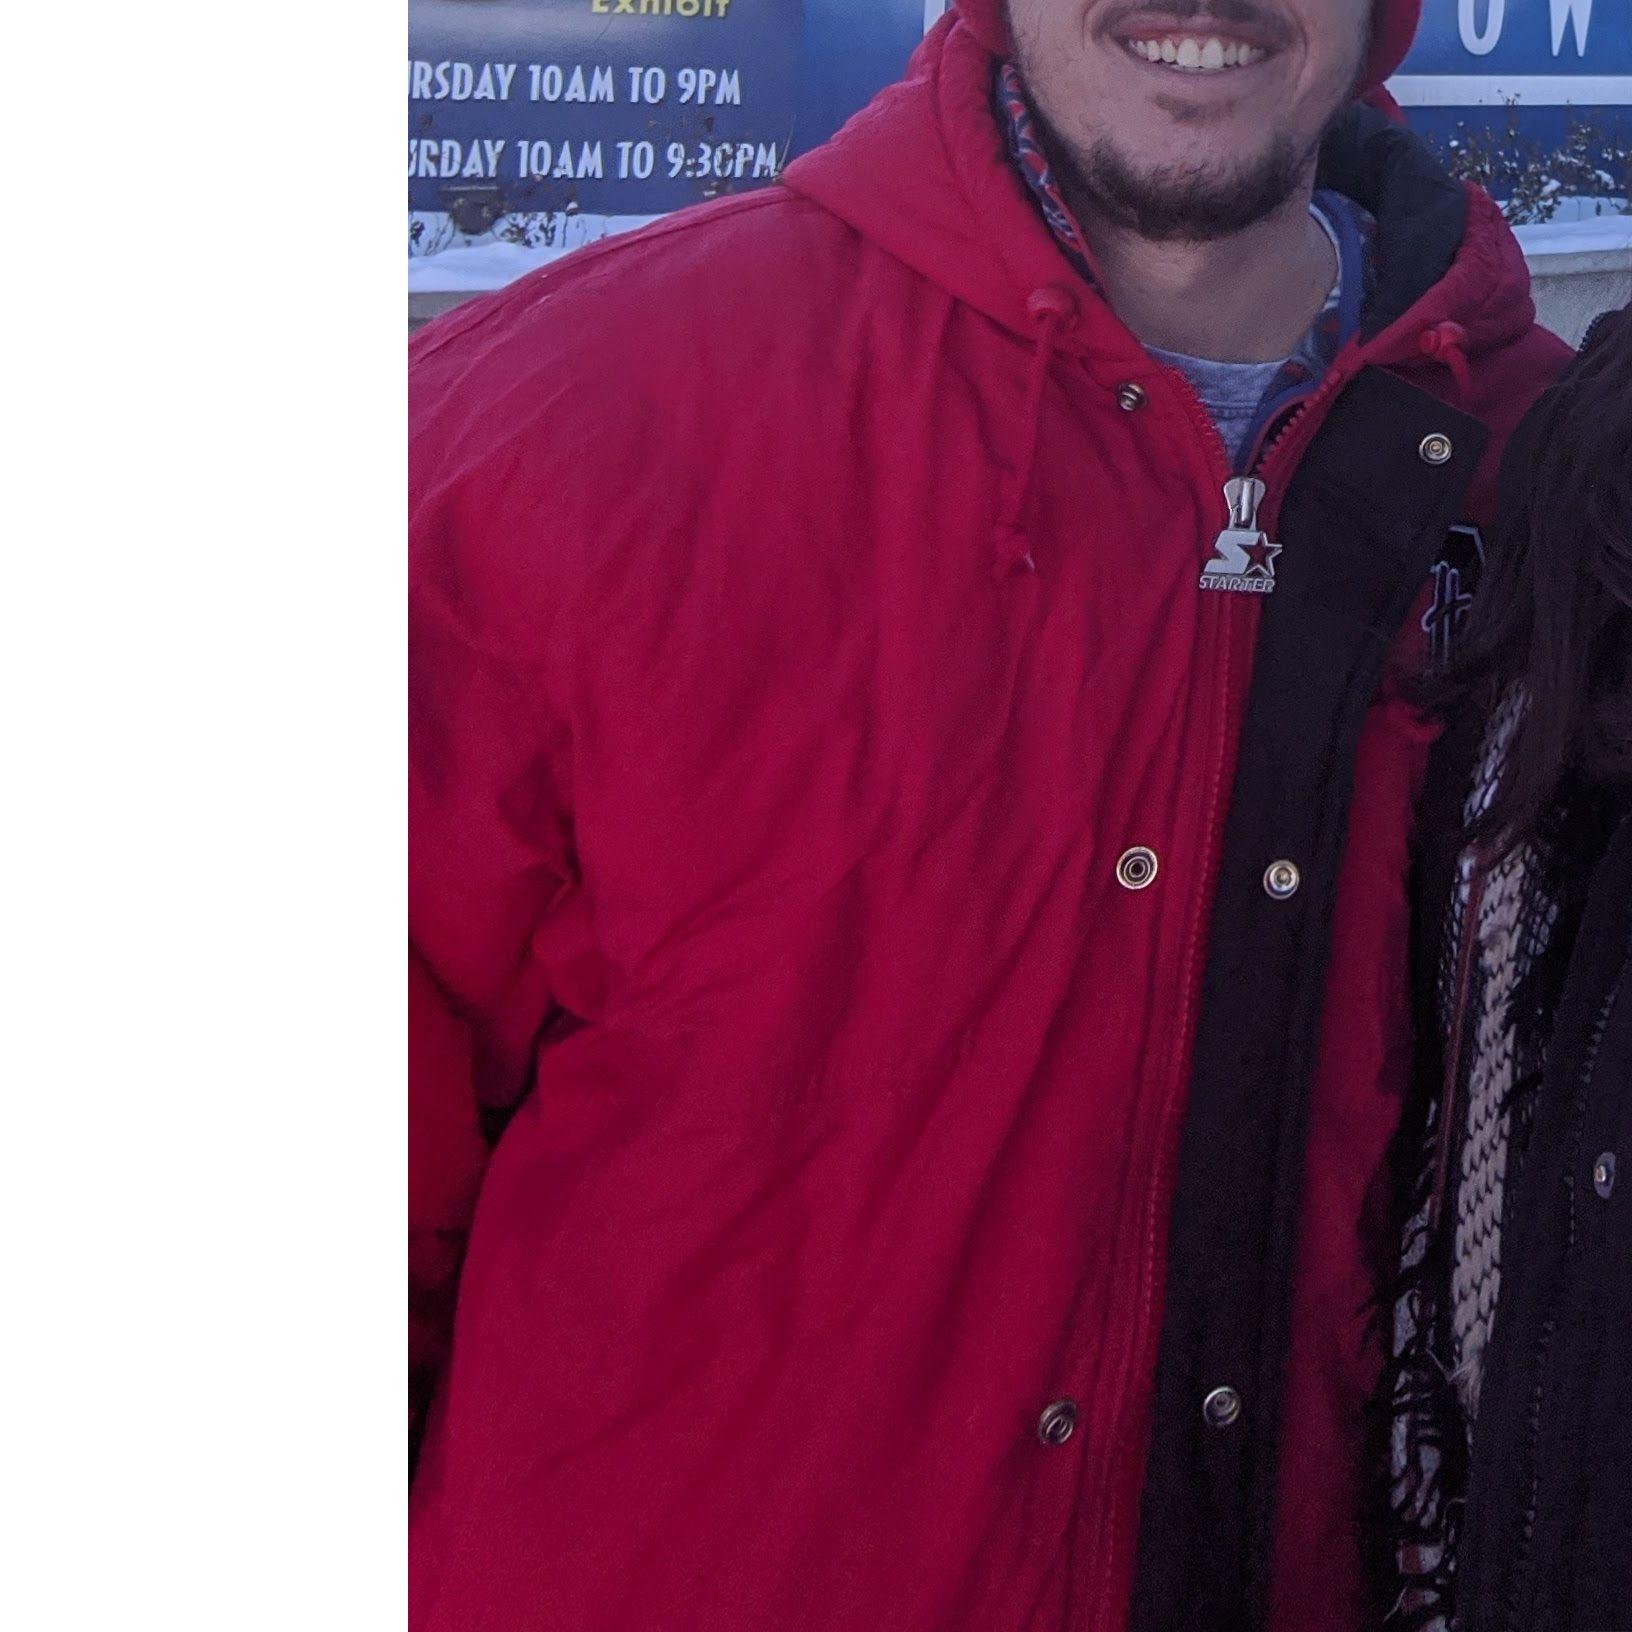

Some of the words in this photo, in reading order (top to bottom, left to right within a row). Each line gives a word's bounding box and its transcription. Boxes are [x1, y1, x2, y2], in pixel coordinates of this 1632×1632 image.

[408, 61, 516, 101] RSDAY
[529, 64, 614, 103] 10AM
[628, 66, 666, 105] TO
[677, 68, 741, 106] 9PM
[517, 140, 603, 179] 10AM
[617, 141, 654, 180] TO
[666, 142, 779, 180] 9:30PM
[1199, 574, 1276, 593] STARTER
